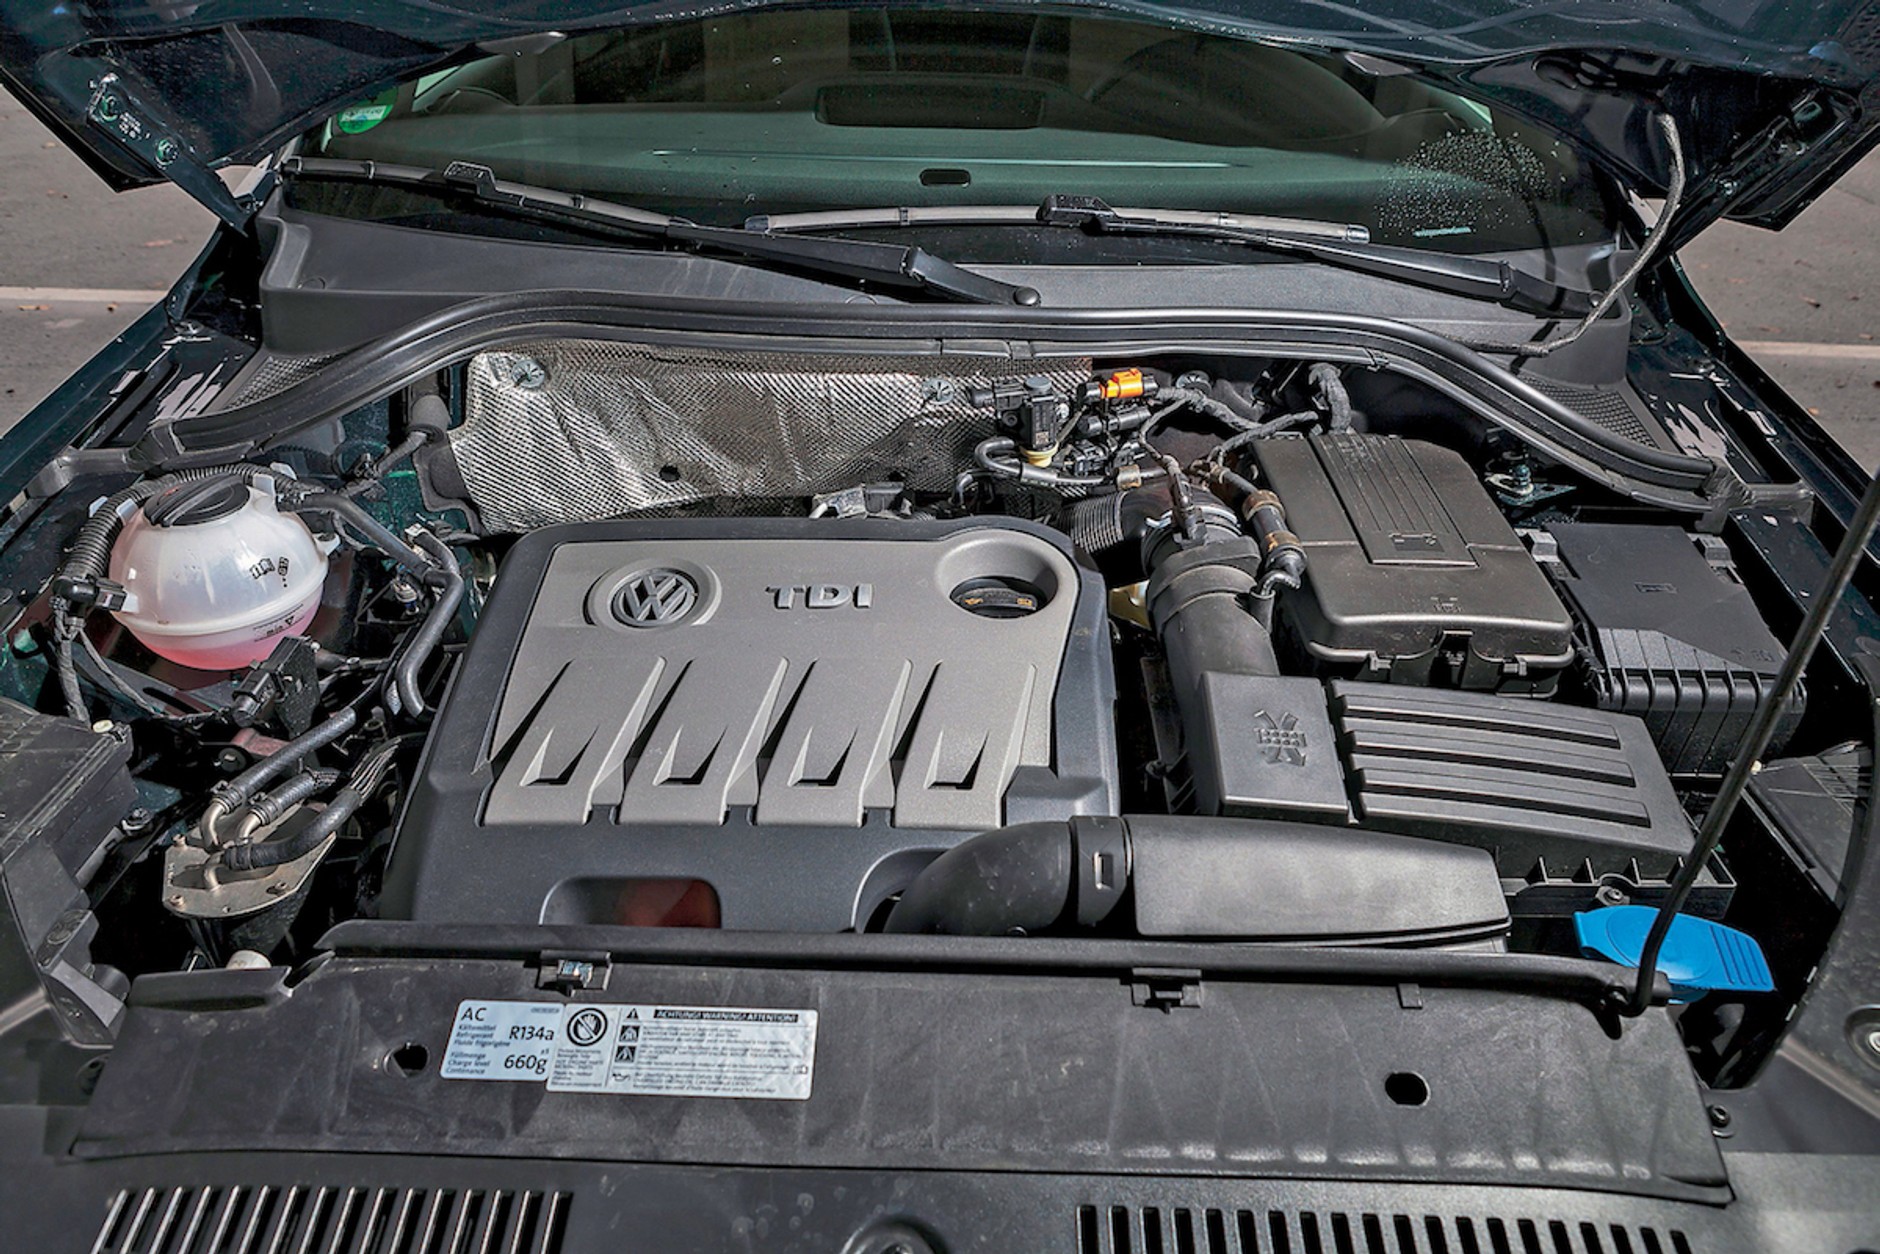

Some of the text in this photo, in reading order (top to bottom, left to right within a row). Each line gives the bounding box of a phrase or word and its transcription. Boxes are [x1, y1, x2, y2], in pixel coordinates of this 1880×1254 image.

[765, 583, 873, 609] TDI
[461, 1007, 487, 1021] AC
[509, 1025, 555, 1041] R134a
[504, 1054, 548, 1075] 660g
